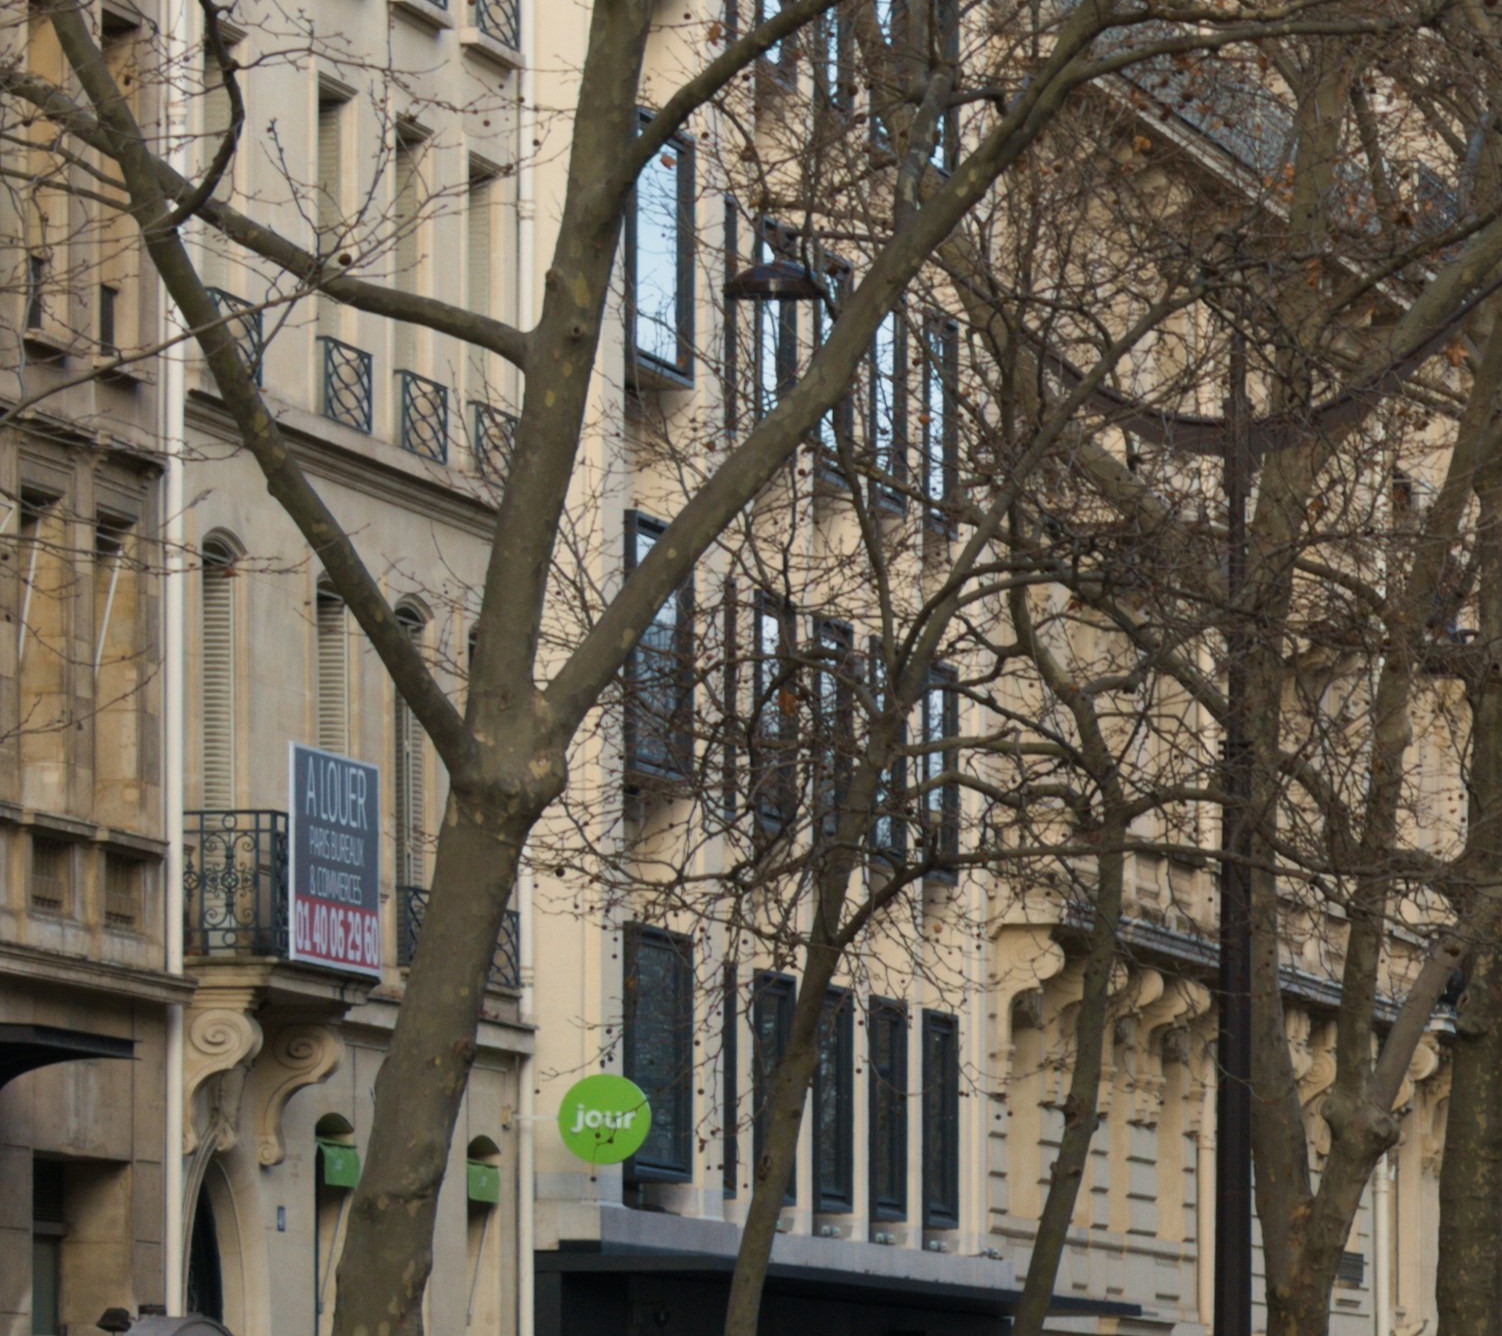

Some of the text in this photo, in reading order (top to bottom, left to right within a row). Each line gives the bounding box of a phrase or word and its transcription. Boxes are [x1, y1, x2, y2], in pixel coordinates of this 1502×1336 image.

[305, 755, 369, 831] A LOUER
[309, 825, 365, 867] PARIS BUREAUX
[310, 865, 363, 905] & COMMERCES
[296, 899, 379, 966] 01 40 06 29 60
[569, 1103, 636, 1134] jour
